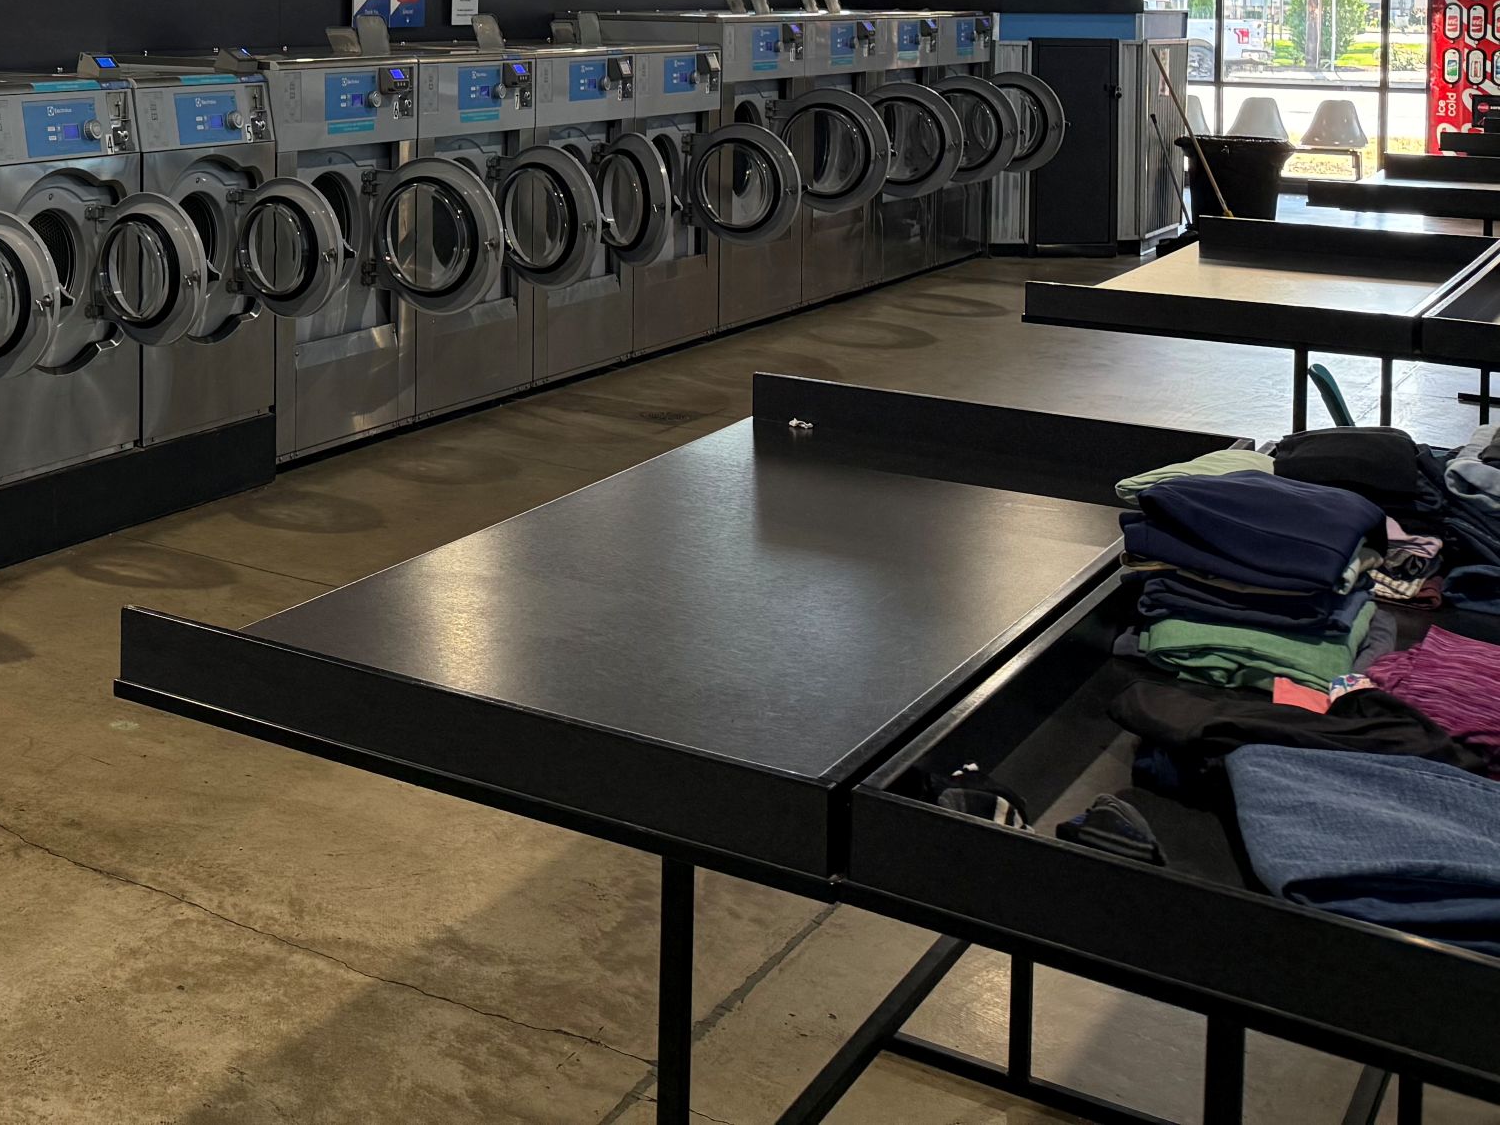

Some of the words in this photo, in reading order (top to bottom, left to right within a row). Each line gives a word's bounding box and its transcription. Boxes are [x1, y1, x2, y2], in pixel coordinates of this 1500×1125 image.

[1436, 100, 1446, 116] Ice
[1446, 92, 1457, 117] cold
[246, 124, 253, 142] 5
[107, 136, 114, 153] 4
